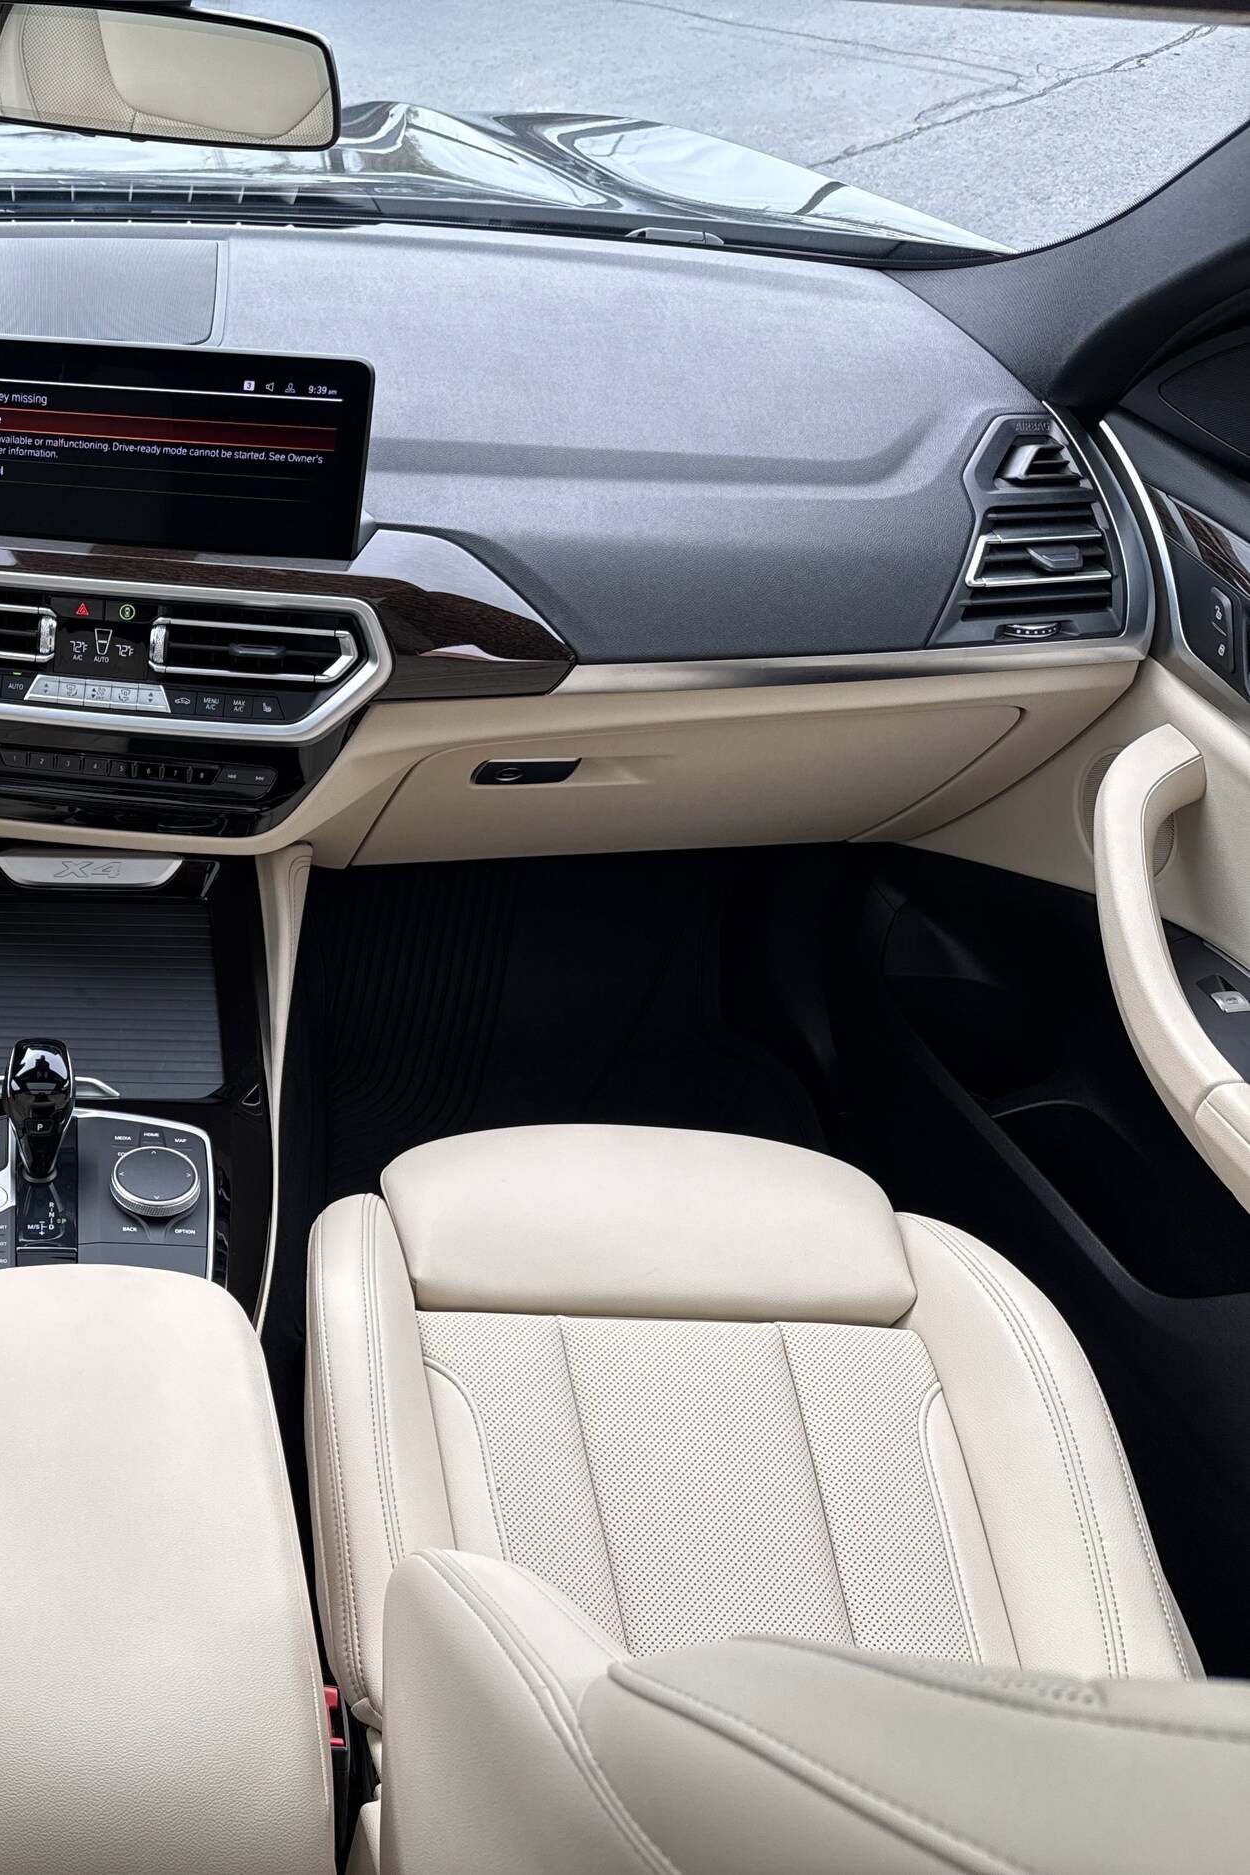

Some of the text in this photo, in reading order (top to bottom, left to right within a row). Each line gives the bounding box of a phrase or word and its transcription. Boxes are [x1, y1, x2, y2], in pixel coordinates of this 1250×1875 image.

[308, 385, 327, 395] 9:39
[11, 393, 48, 406] missing
[1015, 421, 1050, 432] AIRBAG
[8, 447, 59, 459] information.
[34, 438, 44, 446] or
[46, 438, 111, 452] malfunctioning.
[112, 442, 161, 456] Drive-ready
[162, 445, 187, 456] mode
[189, 448, 220, 458] cannot
[221, 450, 232, 459] be
[234, 451, 267, 461] started.
[269, 453, 286, 462] See
[288, 454, 324, 464] Owner's
[94, 656, 110, 664] AUTO
[8, 683, 24, 691] AUTO
[53, 861, 122, 879] X4
